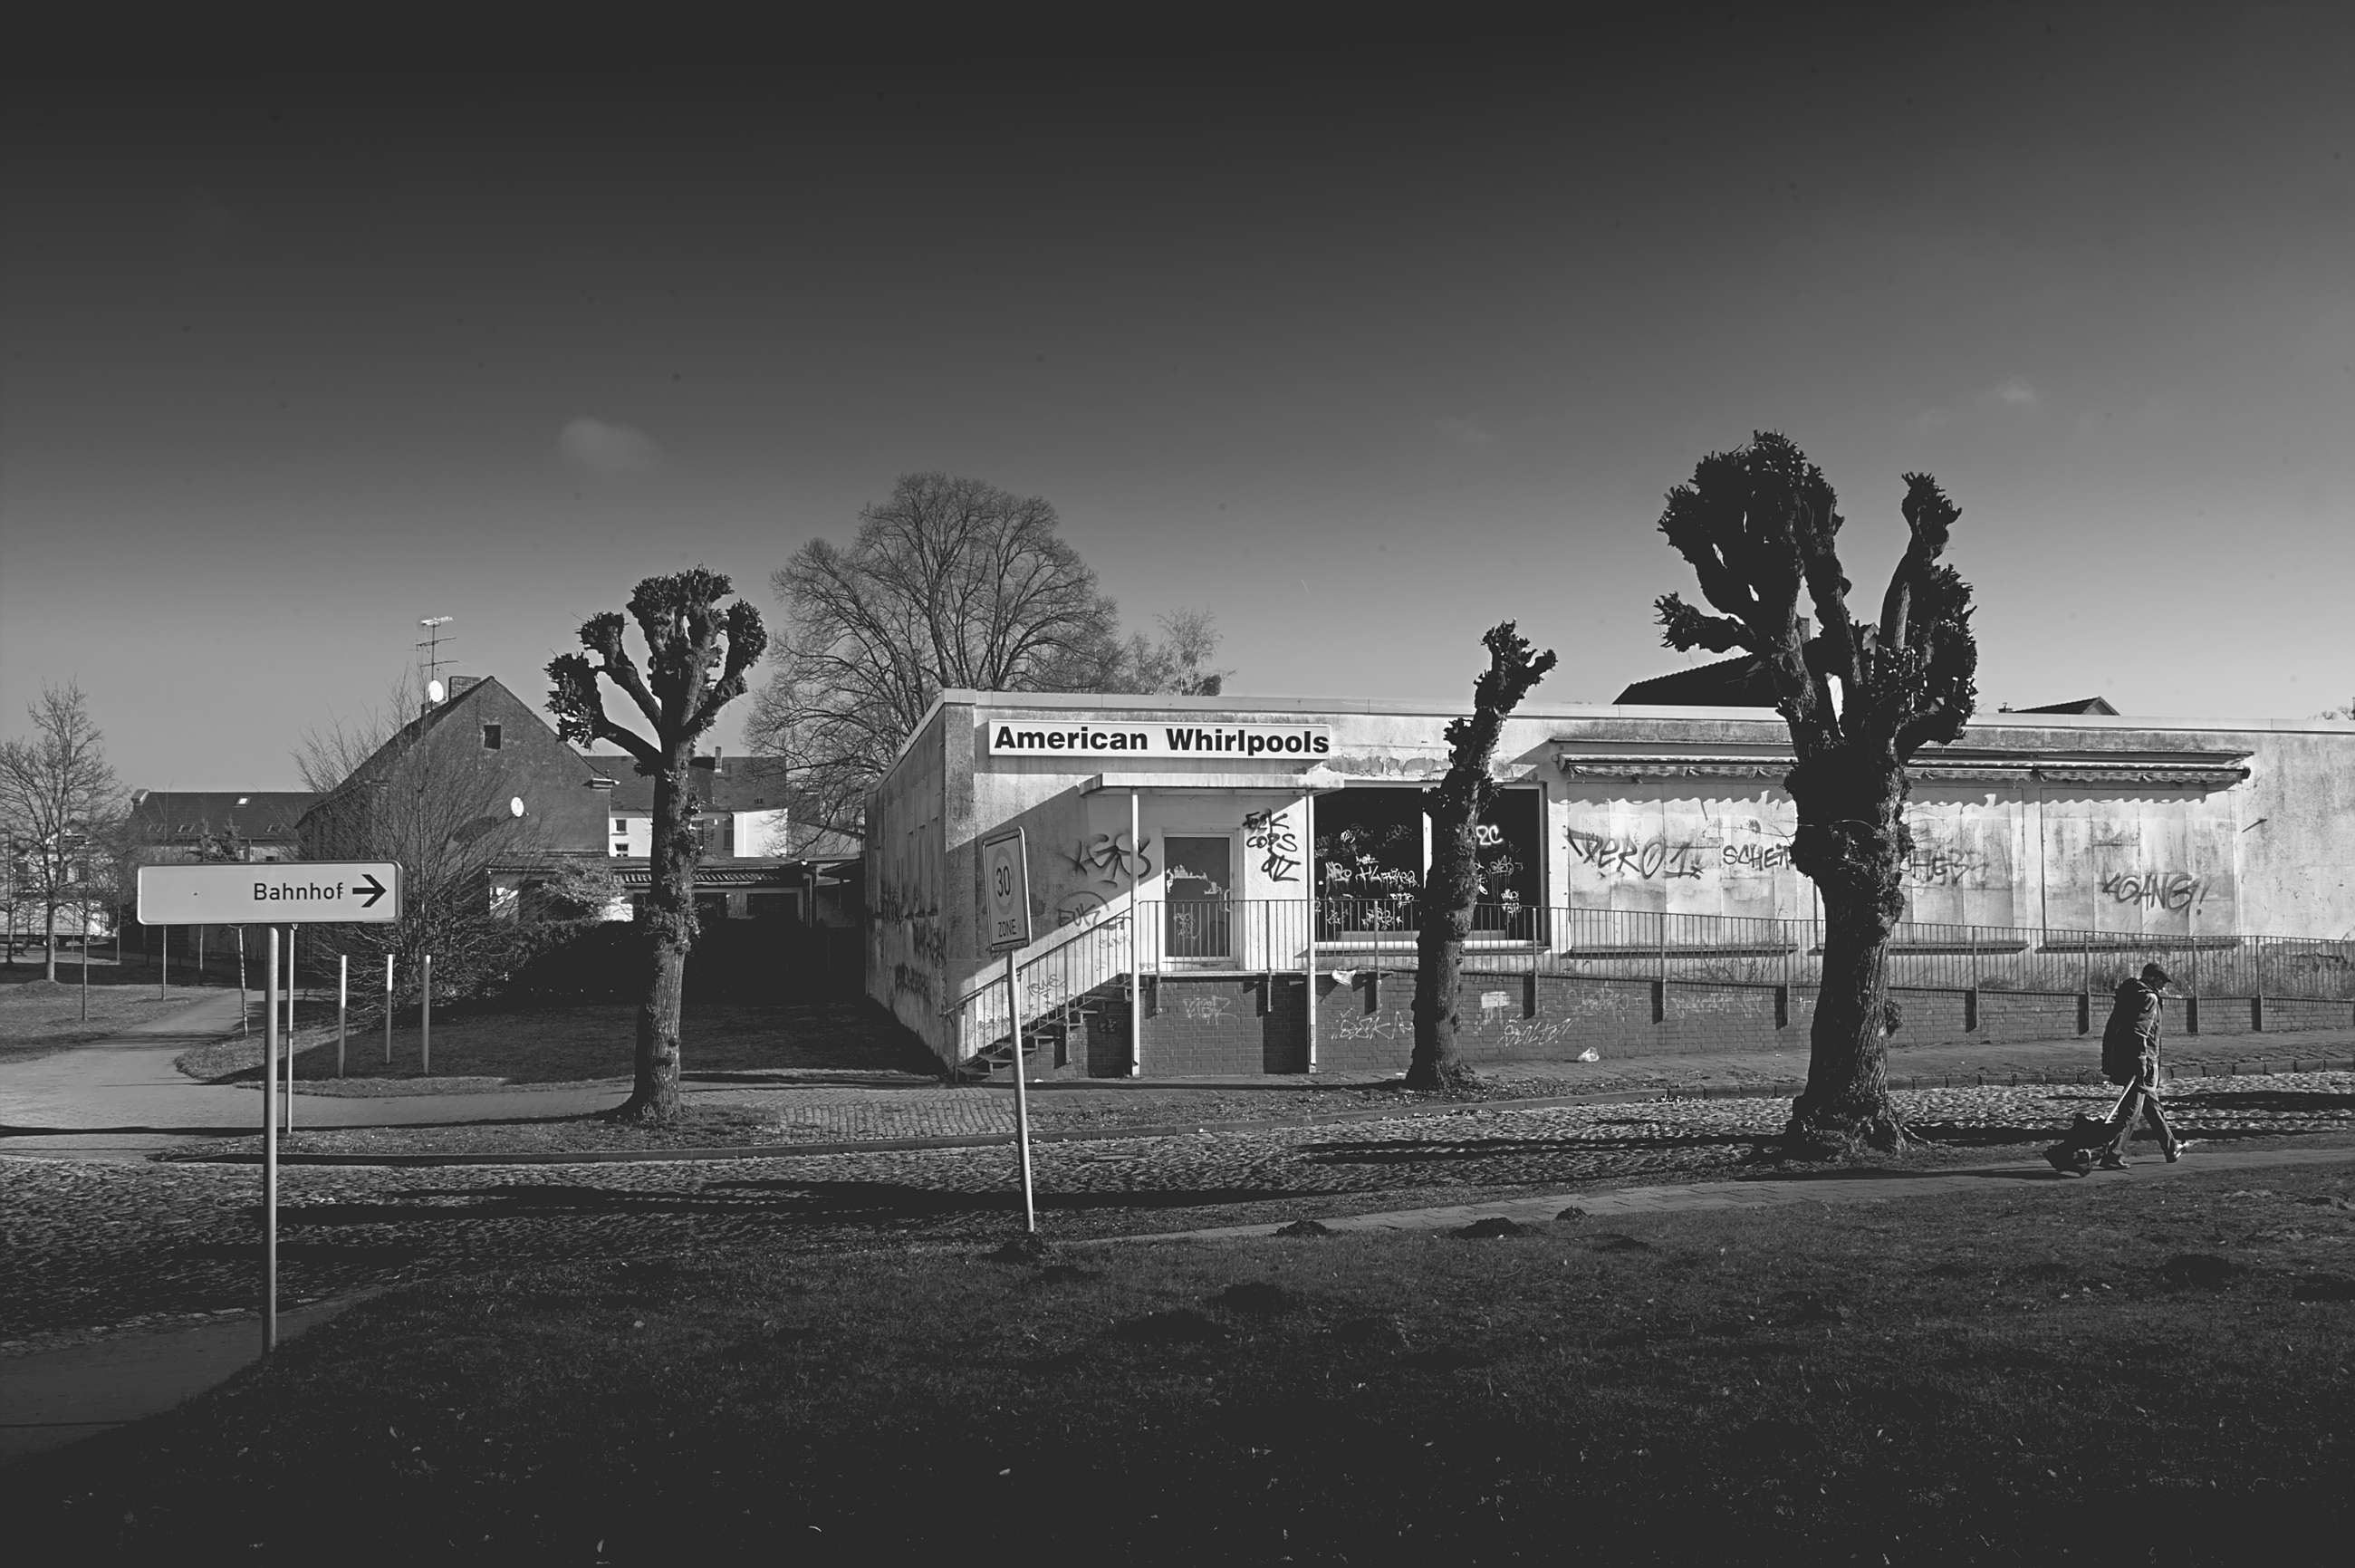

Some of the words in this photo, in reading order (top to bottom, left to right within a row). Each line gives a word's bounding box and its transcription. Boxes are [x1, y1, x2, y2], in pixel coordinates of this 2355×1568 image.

[995, 726, 1148, 750] American
[1166, 727, 1330, 756] Whirlpools
[254, 881, 344, 900] Bahnhof
[996, 865, 1011, 898] 30
[997, 919, 1016, 938] ZONE
